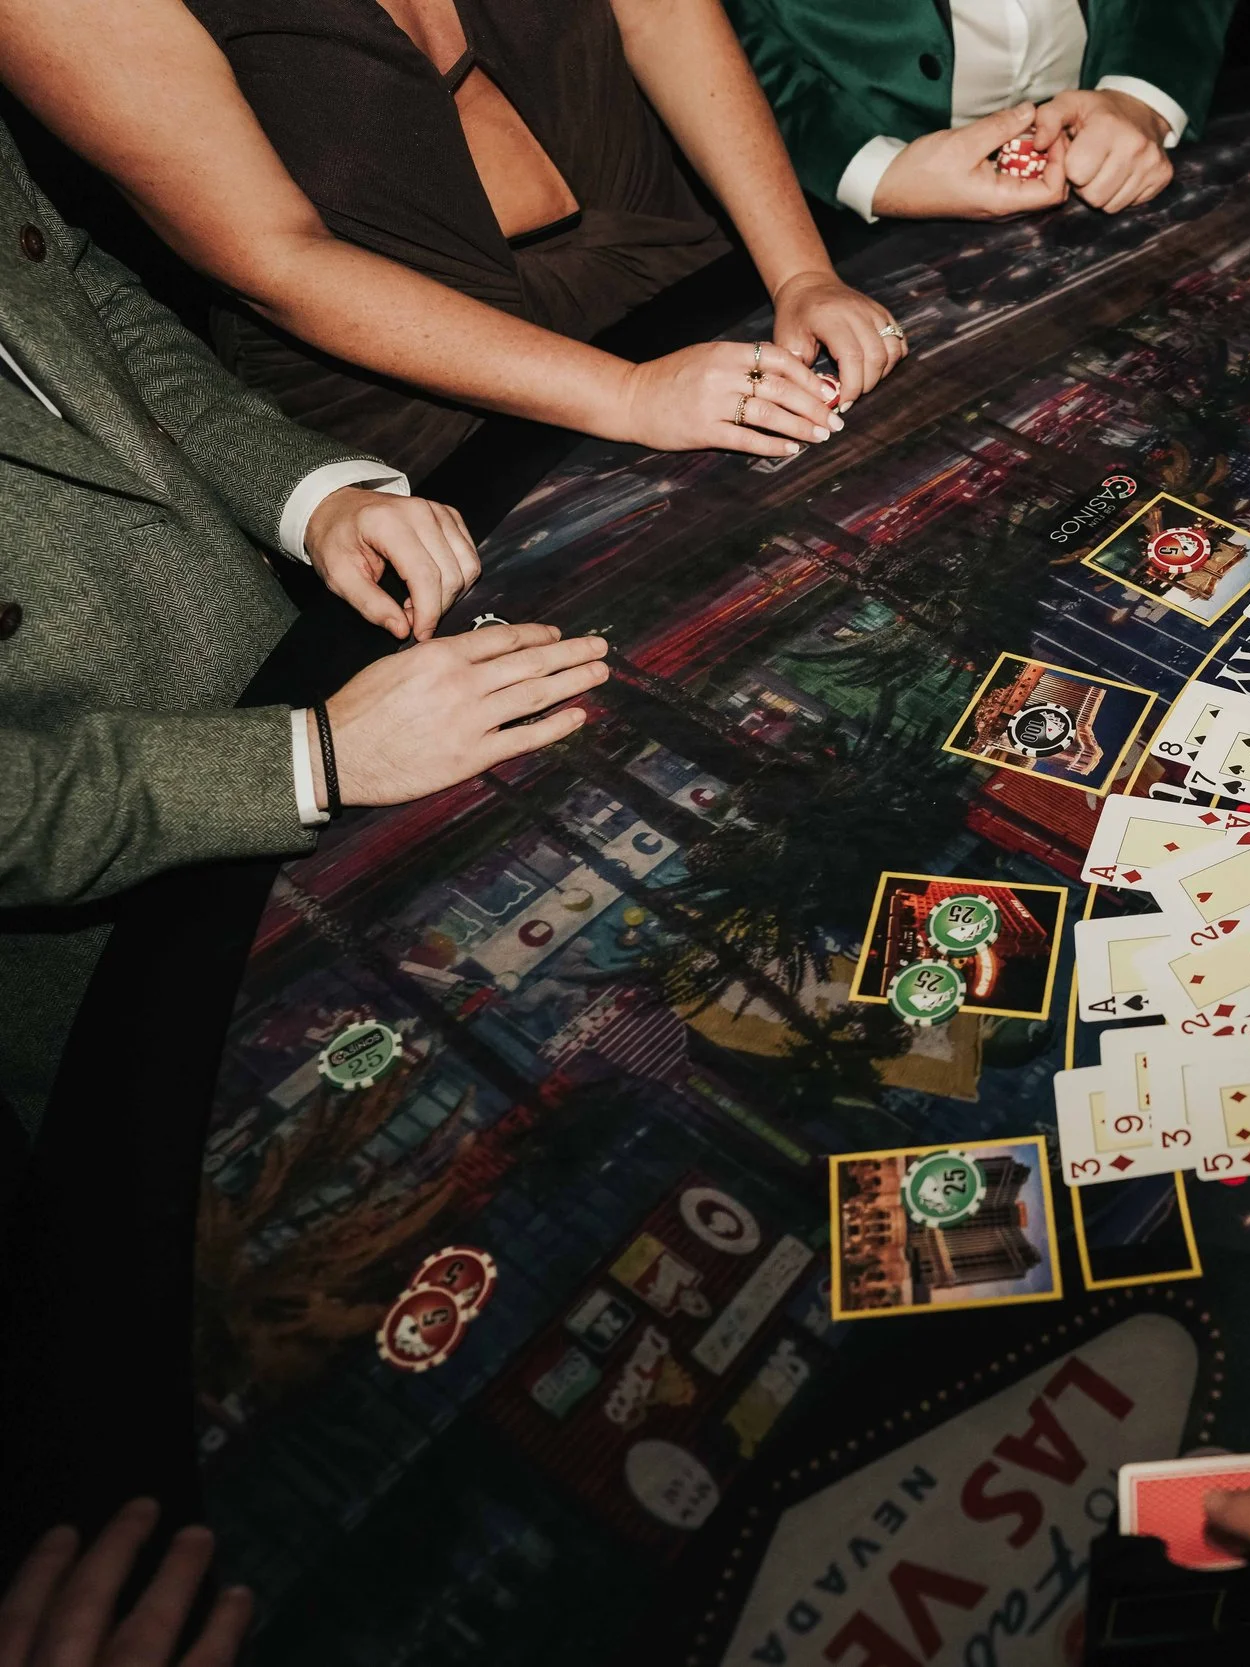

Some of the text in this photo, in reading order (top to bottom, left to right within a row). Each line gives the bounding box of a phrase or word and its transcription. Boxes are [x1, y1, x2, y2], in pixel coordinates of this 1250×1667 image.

[1050, 475, 1137, 543] CASINOS
[1022, 719, 1044, 743] 100
[1158, 741, 1183, 756] 8
[1191, 770, 1217, 786] 7
[1088, 864, 1117, 882] A
[948, 904, 976, 925] 25
[1189, 925, 1218, 946] 2
[913, 970, 945, 993] 25
[1088, 996, 1116, 1015] A
[1181, 1013, 1211, 1035] 2
[348, 1048, 384, 1078] 25
[1161, 1129, 1192, 1148] 3
[1071, 1159, 1101, 1178] 3
[1203, 1153, 1234, 1172] 5
[943, 1168, 967, 1197] 25
[441, 1261, 464, 1286] 5
[422, 1309, 449, 1327] 5
[960, 1356, 1136, 1550] LAS
[751, 1465, 937, 1665] NEVADA
